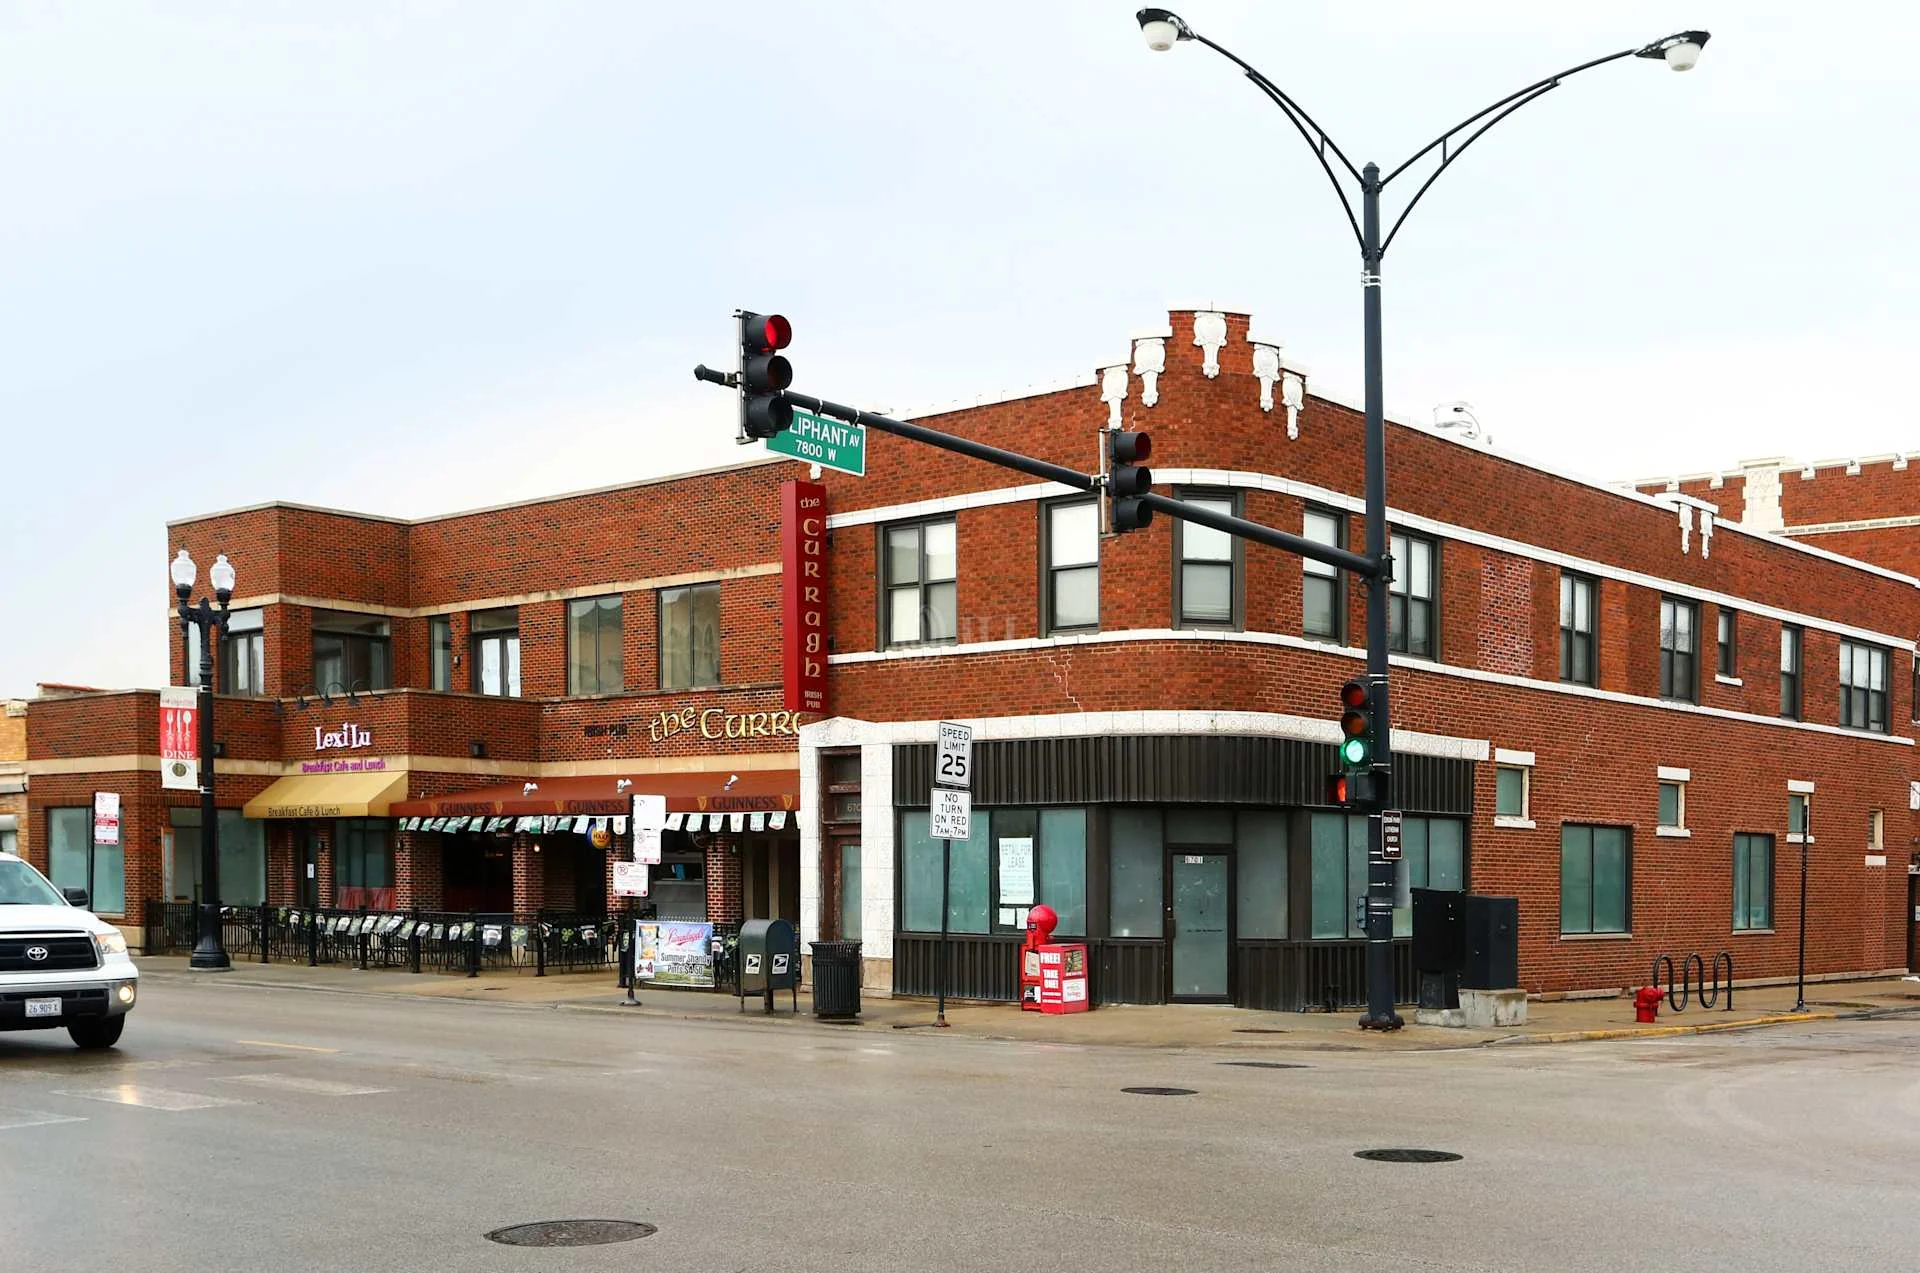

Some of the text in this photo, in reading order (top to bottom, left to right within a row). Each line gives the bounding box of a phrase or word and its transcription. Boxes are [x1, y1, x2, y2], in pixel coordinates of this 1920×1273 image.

[789, 417, 860, 448] LIPHANT AV
[795, 439, 837, 462] 7800 W
[800, 496, 821, 509] the
[804, 690, 823, 700] IRISH
[806, 700, 821, 710] PUB
[649, 706, 696, 742] the
[942, 728, 969, 741] SPEED
[944, 741, 966, 752] LIMIT
[163, 749, 194, 760] DINE
[302, 759, 386, 773] Breakfast Cafe and Lunch
[941, 753, 966, 777] 25
[712, 796, 777, 810] GUINNESS
[945, 793, 959, 803] NO
[268, 806, 341, 817] Breakfast Cafe & Lunch
[441, 802, 491, 815] GUINNESS
[567, 799, 625, 813] GUINNESS
[940, 804, 963, 814] TURN
[935, 814, 967, 826] ON RED
[661, 952, 712, 967] Summer Shandy
